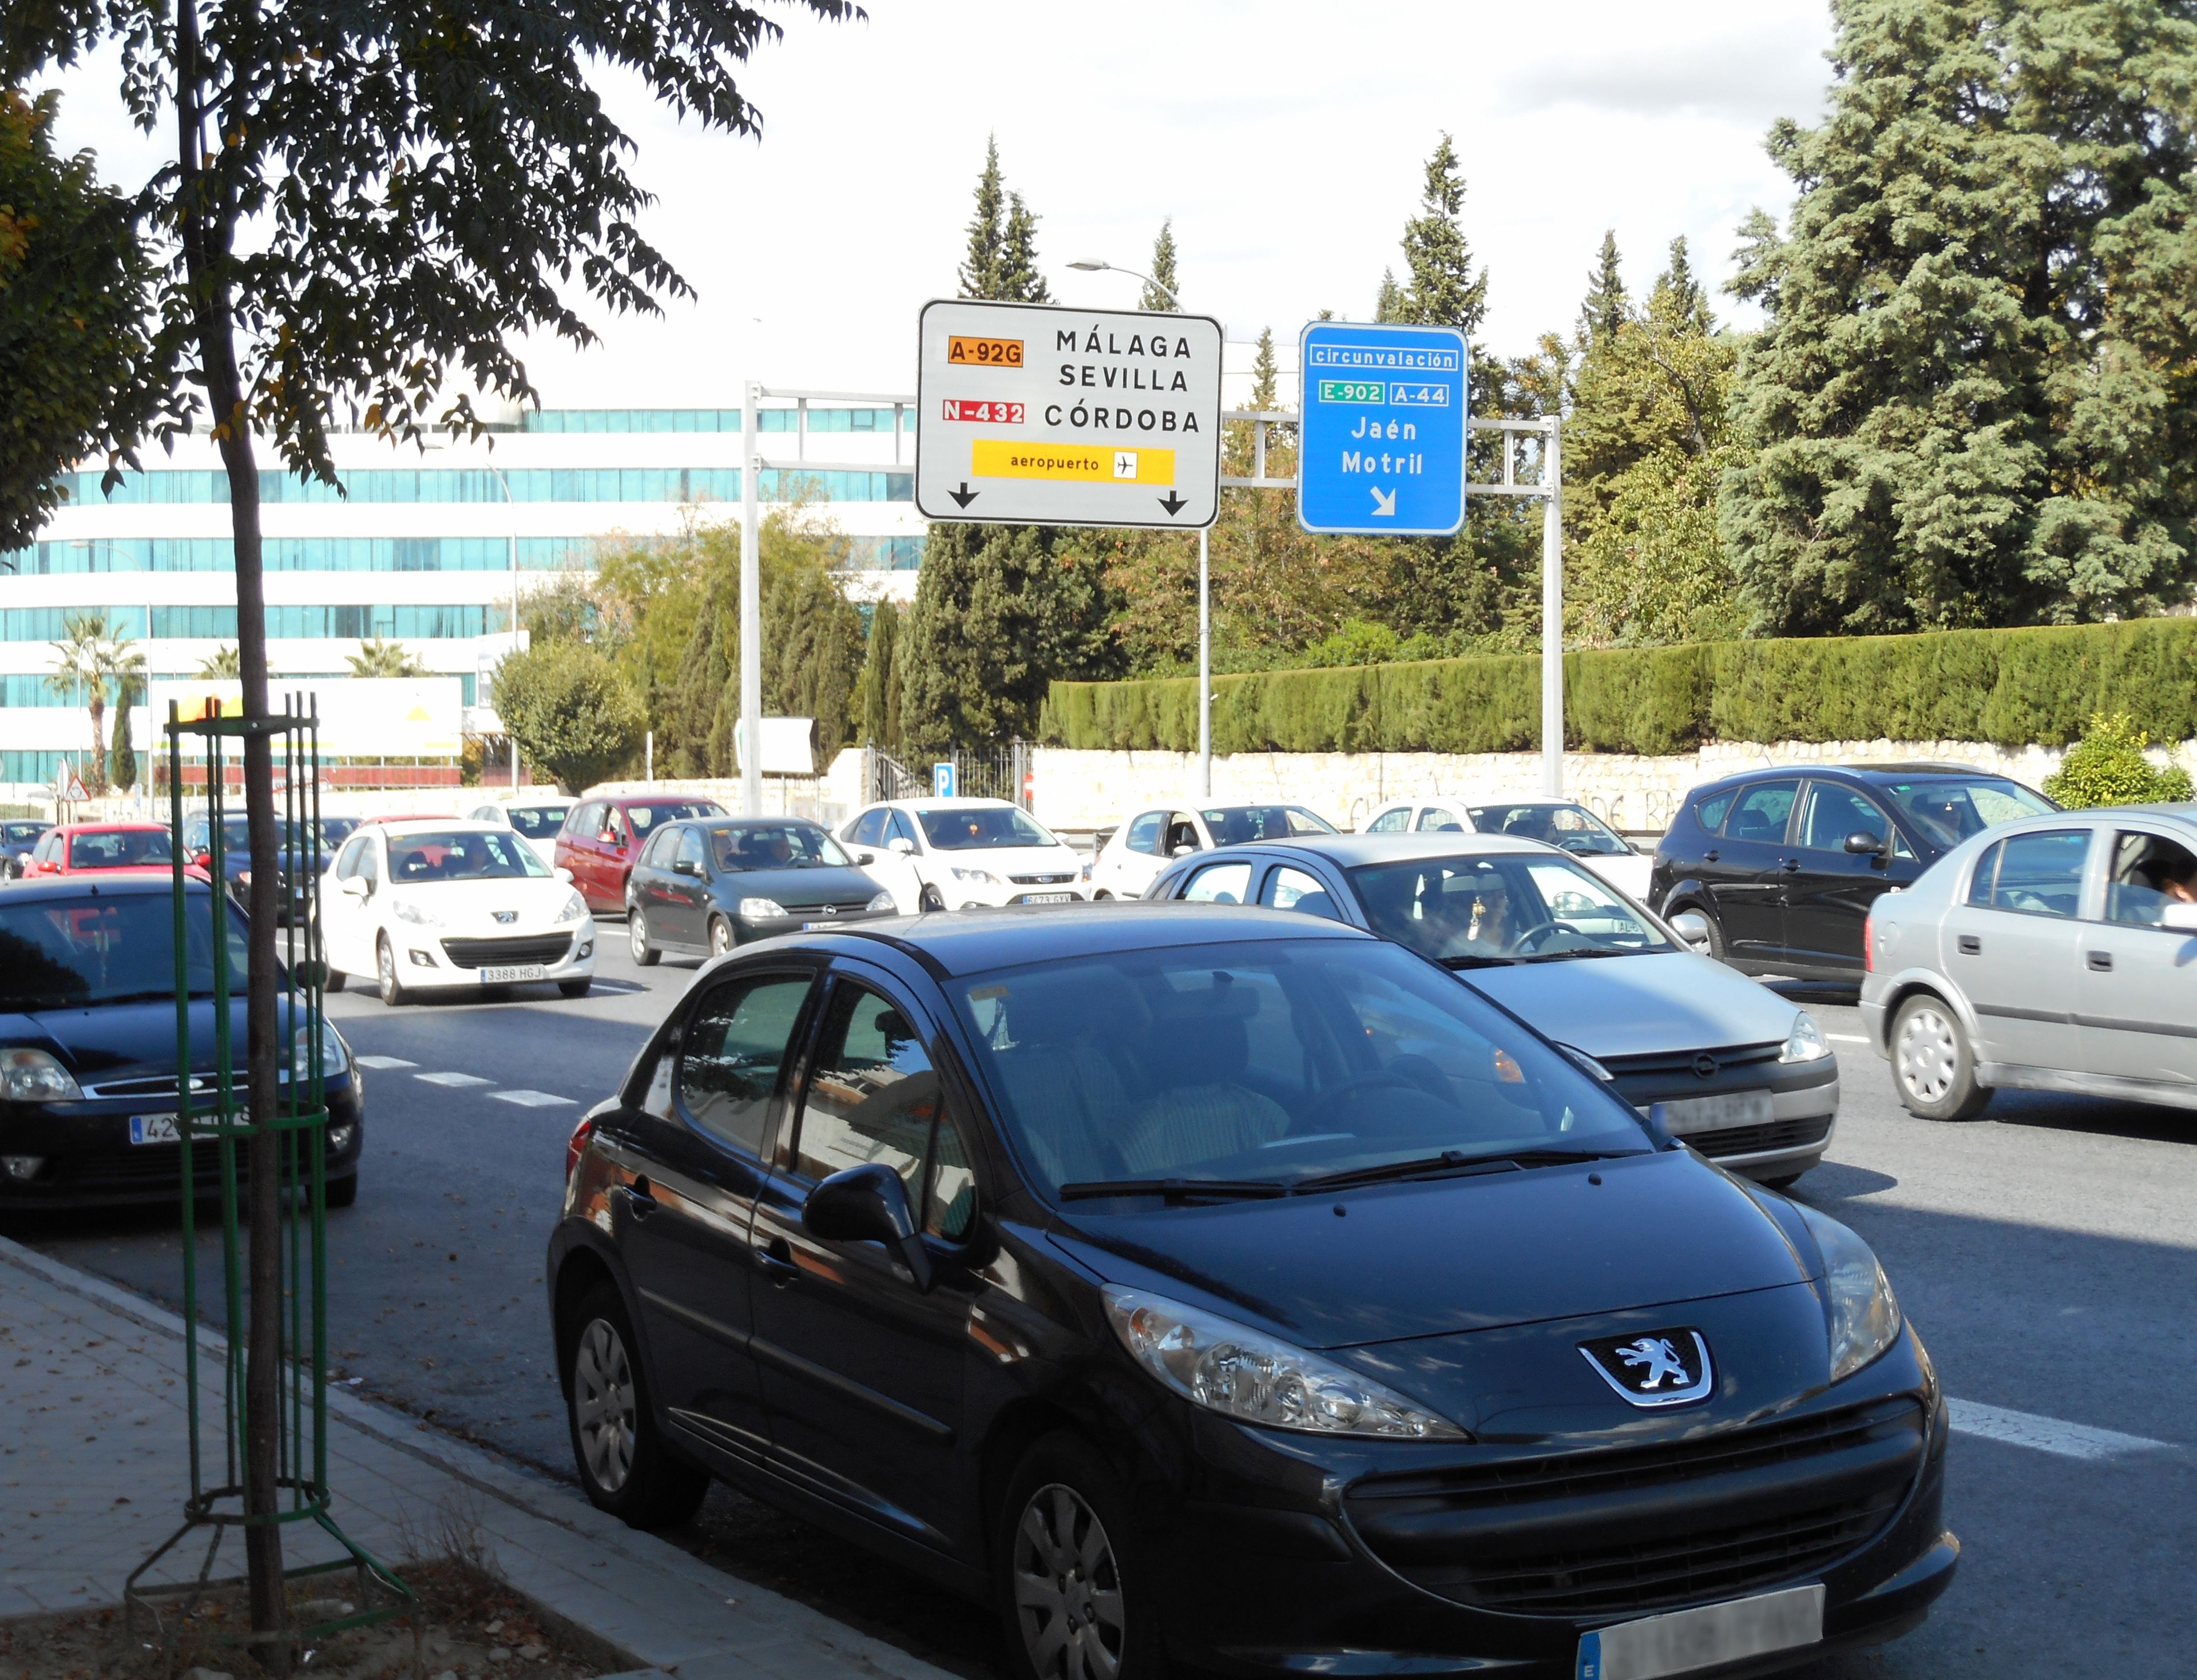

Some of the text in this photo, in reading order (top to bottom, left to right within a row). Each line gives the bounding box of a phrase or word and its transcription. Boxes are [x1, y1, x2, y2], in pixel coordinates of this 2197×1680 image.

[950, 341, 1021, 363] A-92G
[1057, 324, 1191, 358] MÁLAGA
[1315, 348, 1453, 367] circunvalación
[1059, 364, 1187, 391] SEVILLA
[1324, 384, 1445, 403] E-902 A-44
[944, 401, 1024, 423] N-432
[1045, 399, 1199, 432] CÓRDOBA
[1351, 417, 1416, 439] Jaén
[1011, 455, 1098, 470] aeropuerto
[1342, 451, 1422, 474] Motril
[938, 769, 949, 797] P
[1620, 922, 1639, 932] AL-6
[488, 968, 541, 980] 3388 HGJ
[1584, 1665, 1595, 1677] E
